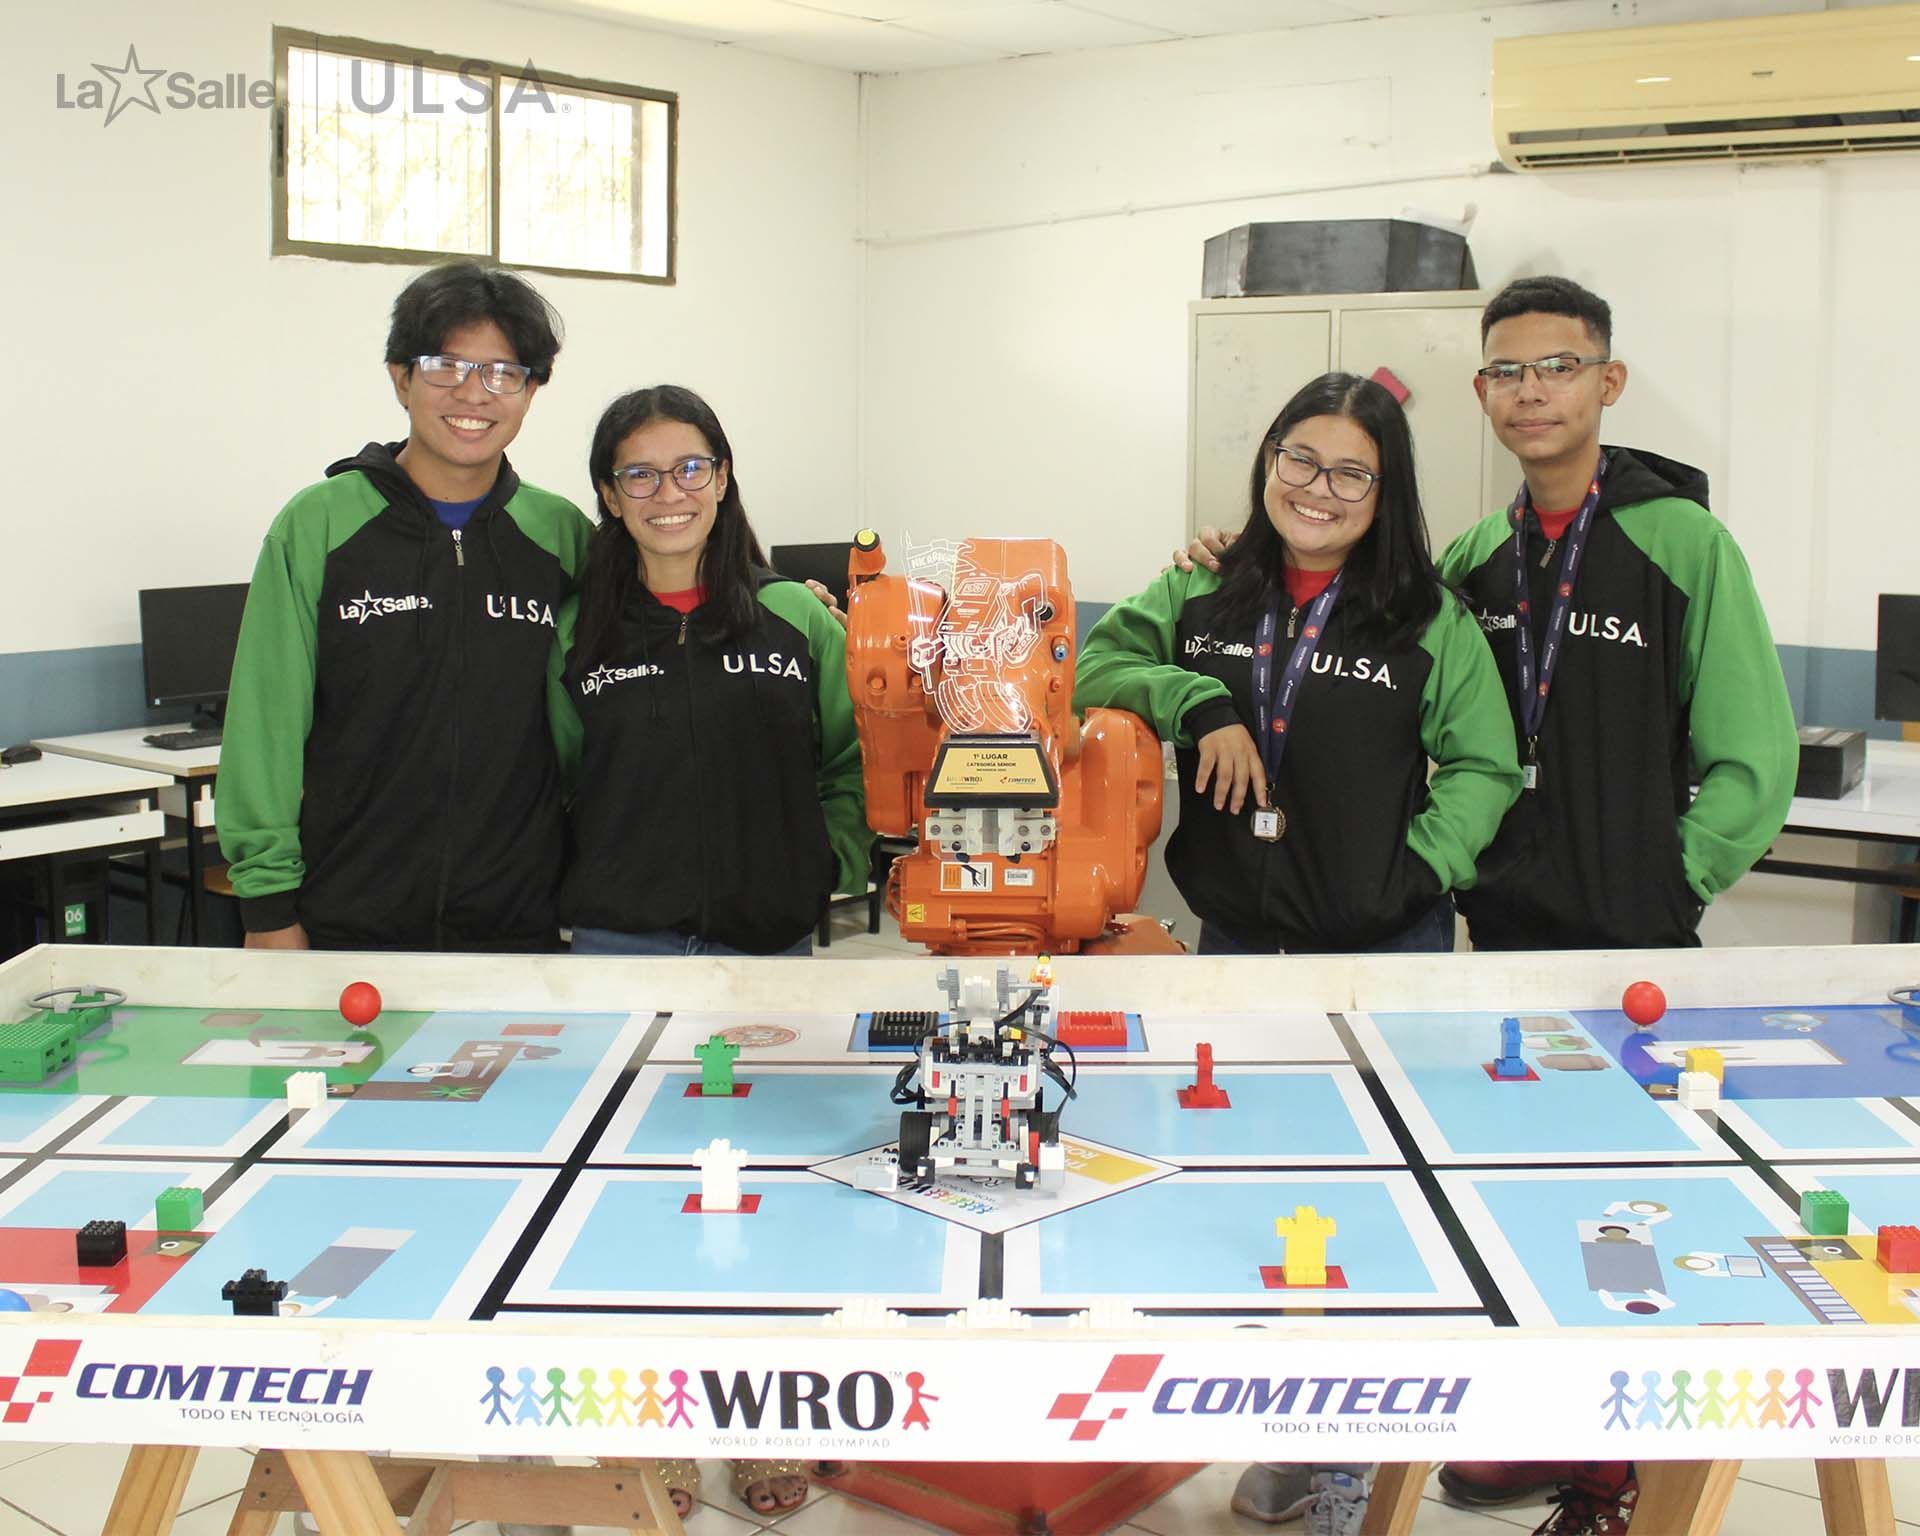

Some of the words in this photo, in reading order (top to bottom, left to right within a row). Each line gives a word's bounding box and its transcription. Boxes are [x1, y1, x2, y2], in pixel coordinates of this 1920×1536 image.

[65, 908, 82, 923] 06
[76, 1362, 374, 1406] COMTECH
[1152, 1377, 1472, 1415] COMTECH
[180, 1407, 225, 1421] TODO
[231, 1409, 252, 1421] EN
[260, 1410, 364, 1424] TECNOLOGÍA
[1261, 1421, 1310, 1433] TODO
[1317, 1422, 1340, 1433] EN
[1346, 1420, 1458, 1434] TECNOLOGÍA
[709, 1436, 758, 1447] WORLD
[765, 1436, 812, 1448] ROBOT
[820, 1437, 891, 1449] OLYMPIAD
[1829, 1434, 1878, 1445] WORLD
